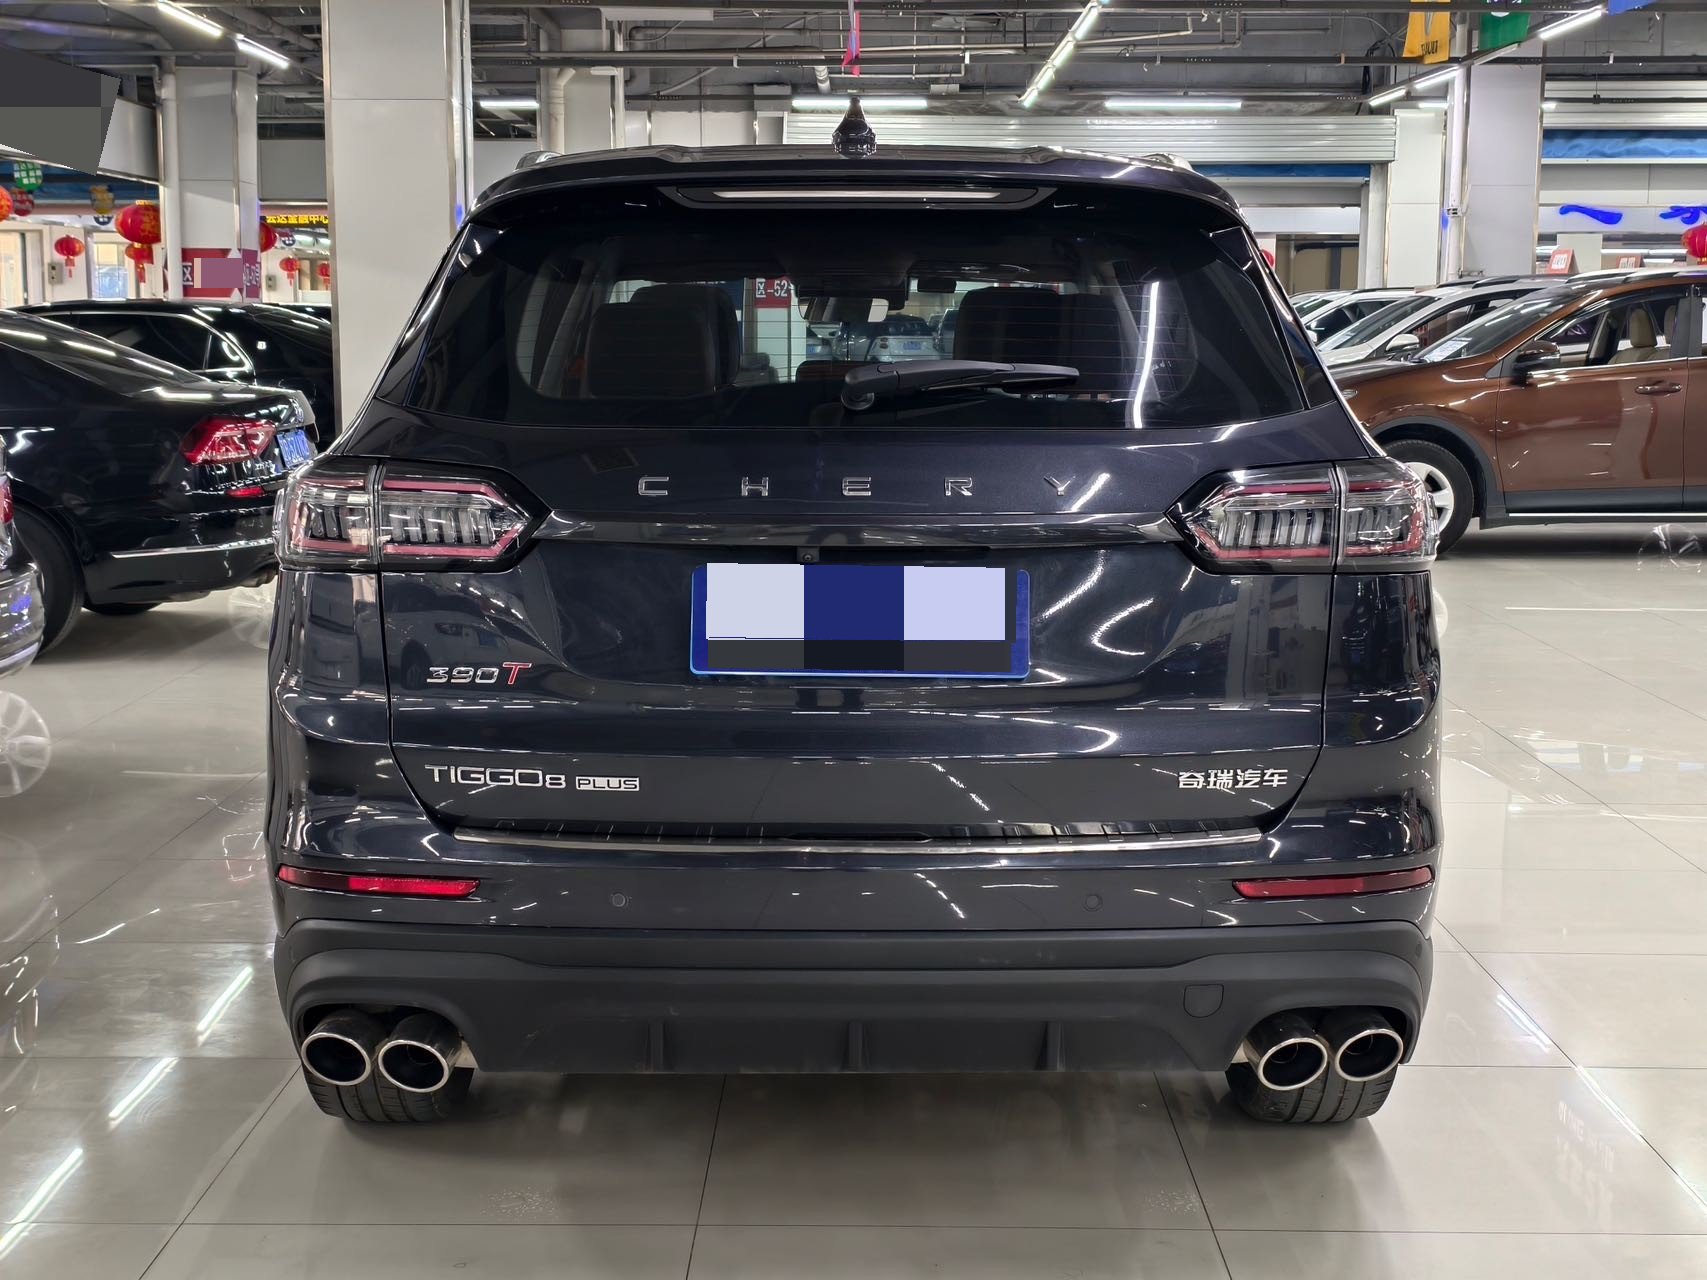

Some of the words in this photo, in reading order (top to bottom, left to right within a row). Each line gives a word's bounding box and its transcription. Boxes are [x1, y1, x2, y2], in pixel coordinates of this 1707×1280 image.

[637, 475, 1076, 497] CHERY
[426, 661, 532, 685] 390T
[575, 776, 640, 792] PLUS
[1178, 769, 1289, 790] 奇瑞汽车
